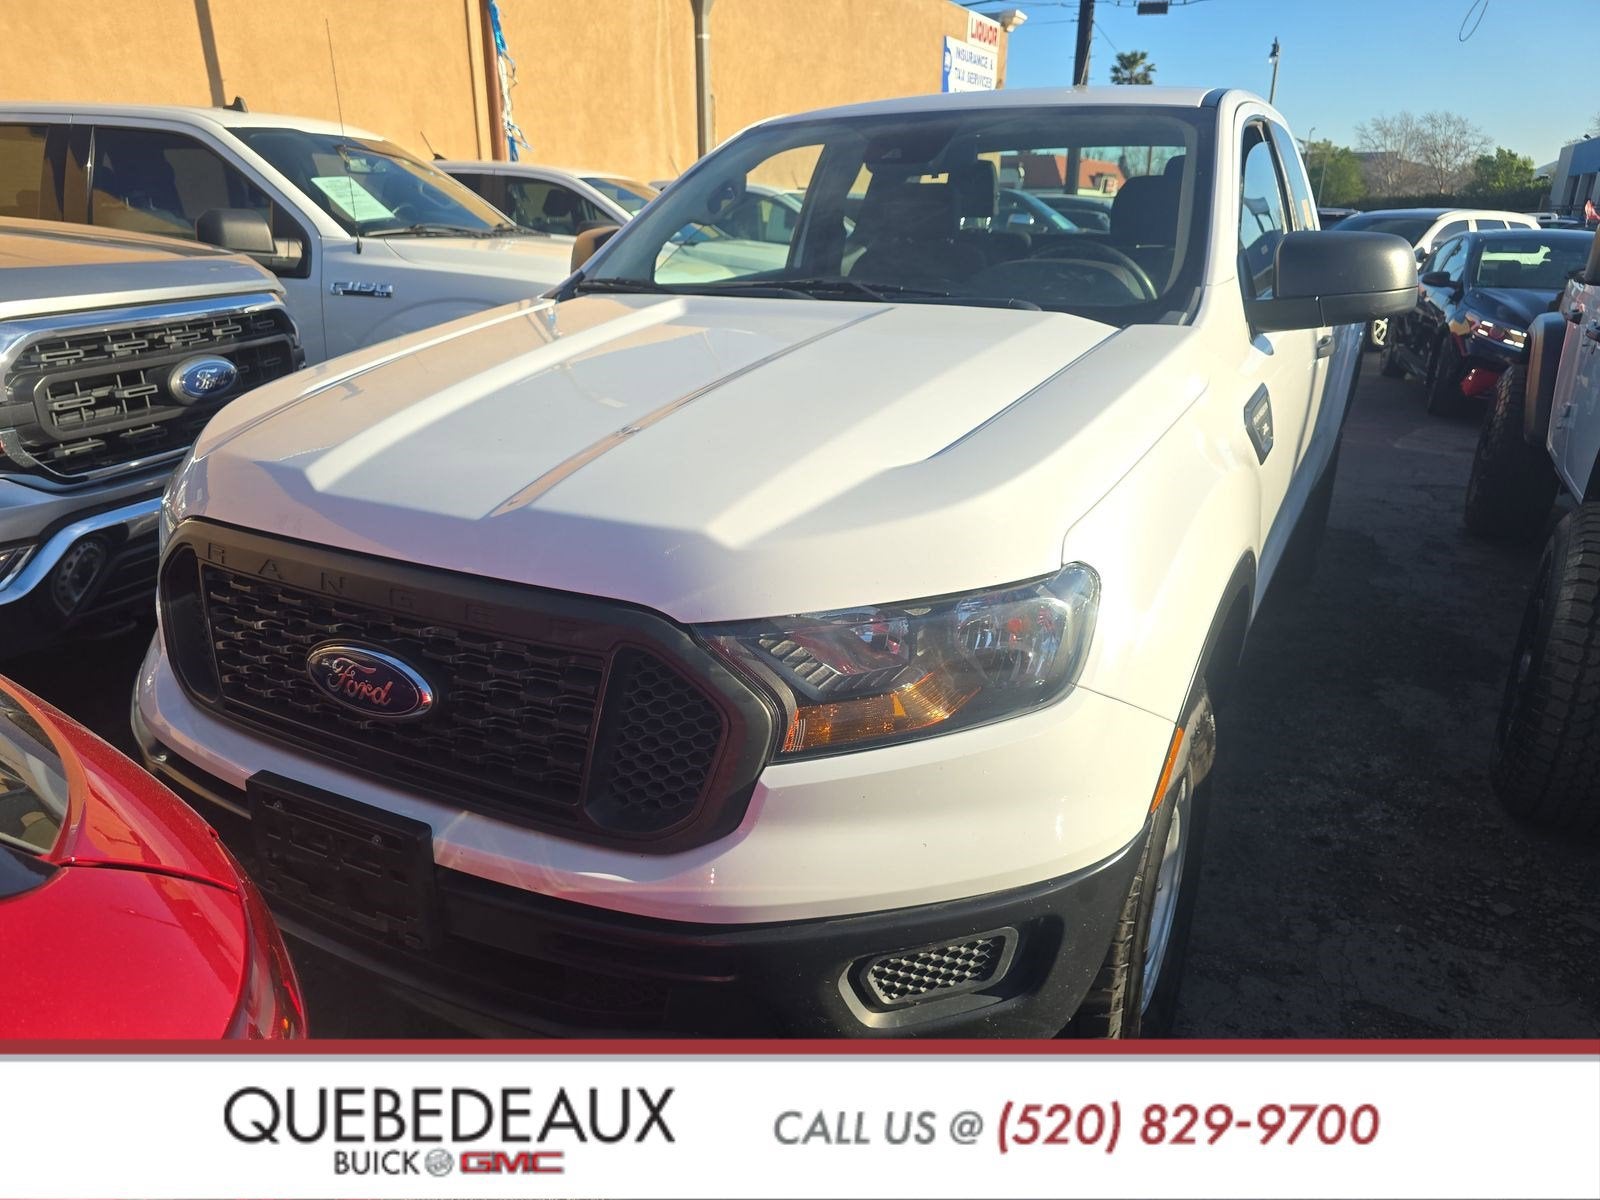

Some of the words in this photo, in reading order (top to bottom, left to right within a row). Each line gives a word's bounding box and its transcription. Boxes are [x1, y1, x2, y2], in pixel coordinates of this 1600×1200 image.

[970, 17, 998, 47] LIQUOR
[955, 46, 988, 70] INSURANCE
[207, 541, 592, 640] RANGER
[326, 657, 394, 705] Ford
